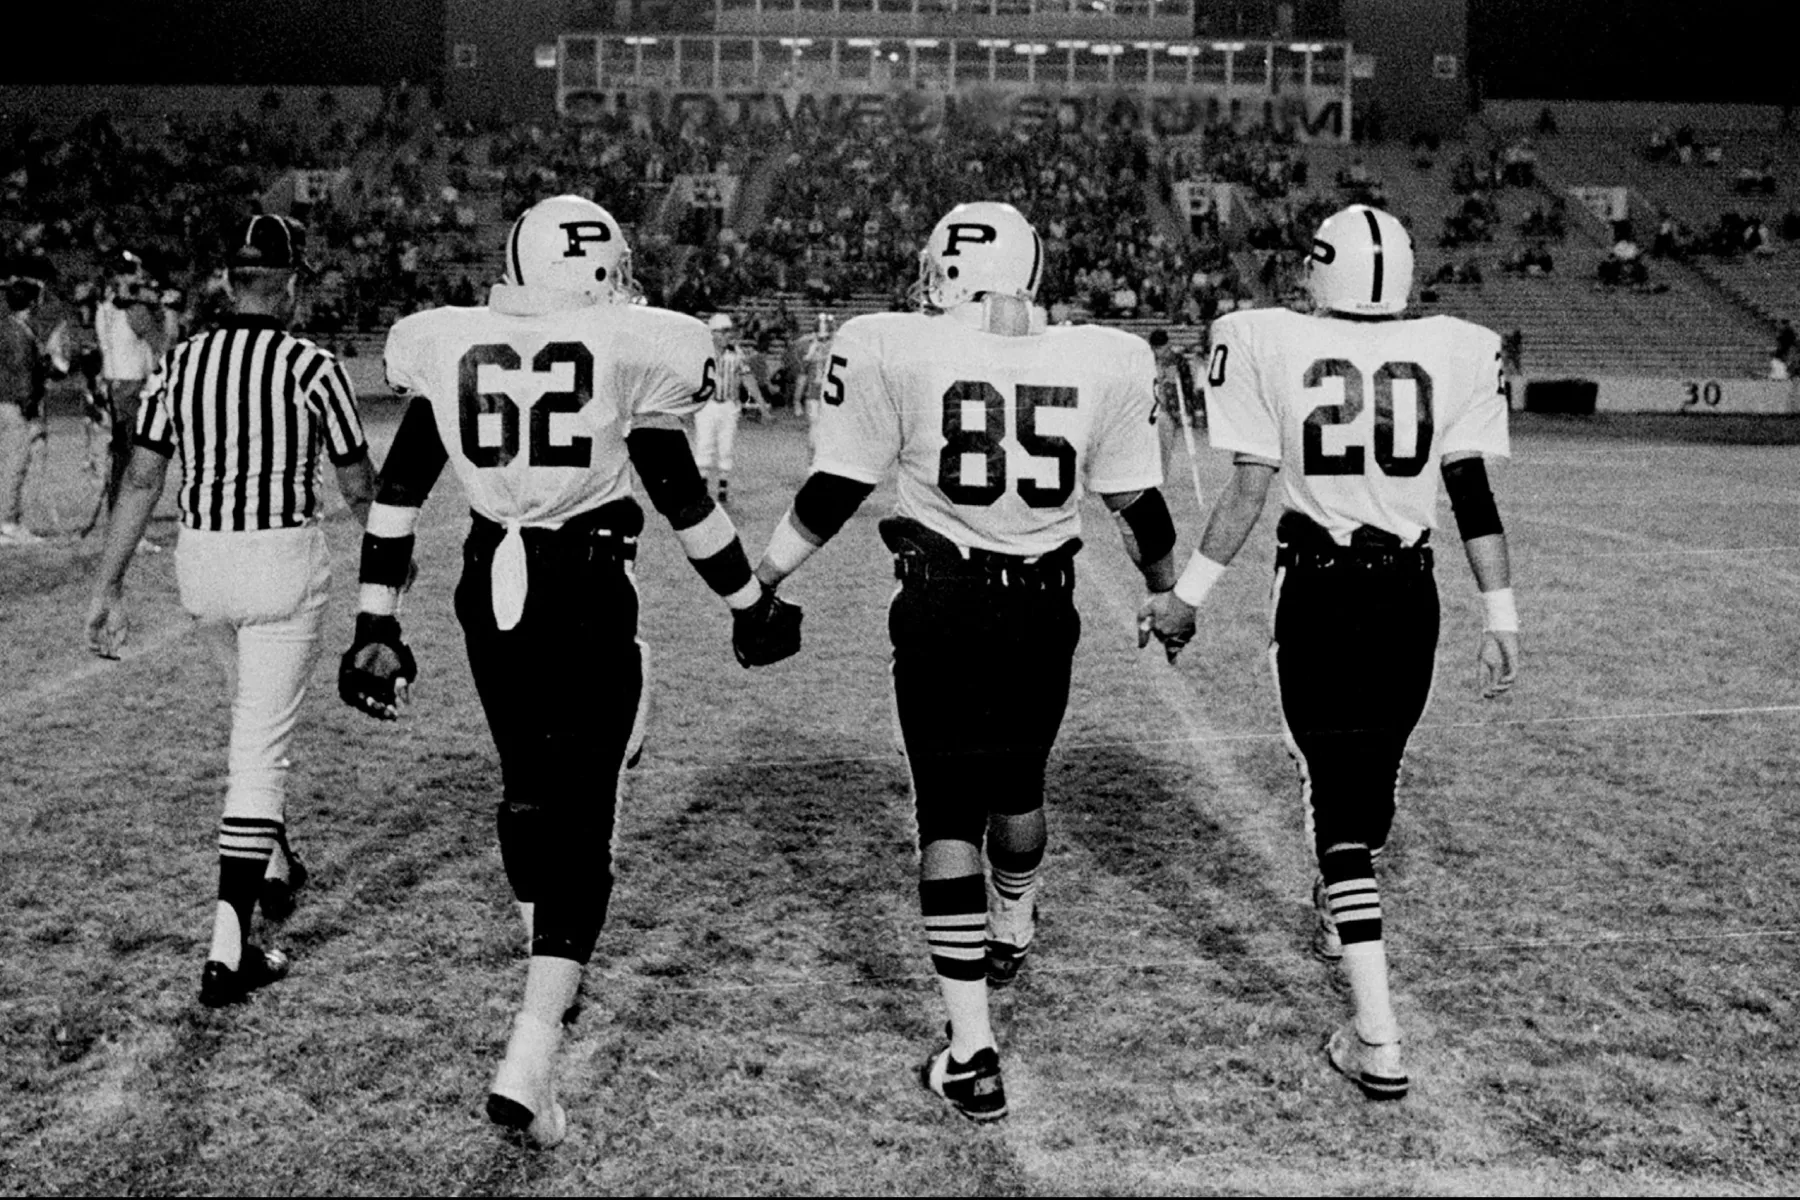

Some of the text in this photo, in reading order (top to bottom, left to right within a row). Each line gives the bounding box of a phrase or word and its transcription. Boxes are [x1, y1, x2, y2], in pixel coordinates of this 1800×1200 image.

[559, 221, 611, 258] P
[941, 222, 997, 257] P
[458, 341, 595, 469] 62
[823, 354, 848, 408] 5
[1683, 381, 1722, 406] 30
[1302, 358, 1435, 478] 20
[939, 380, 1078, 511] 85
